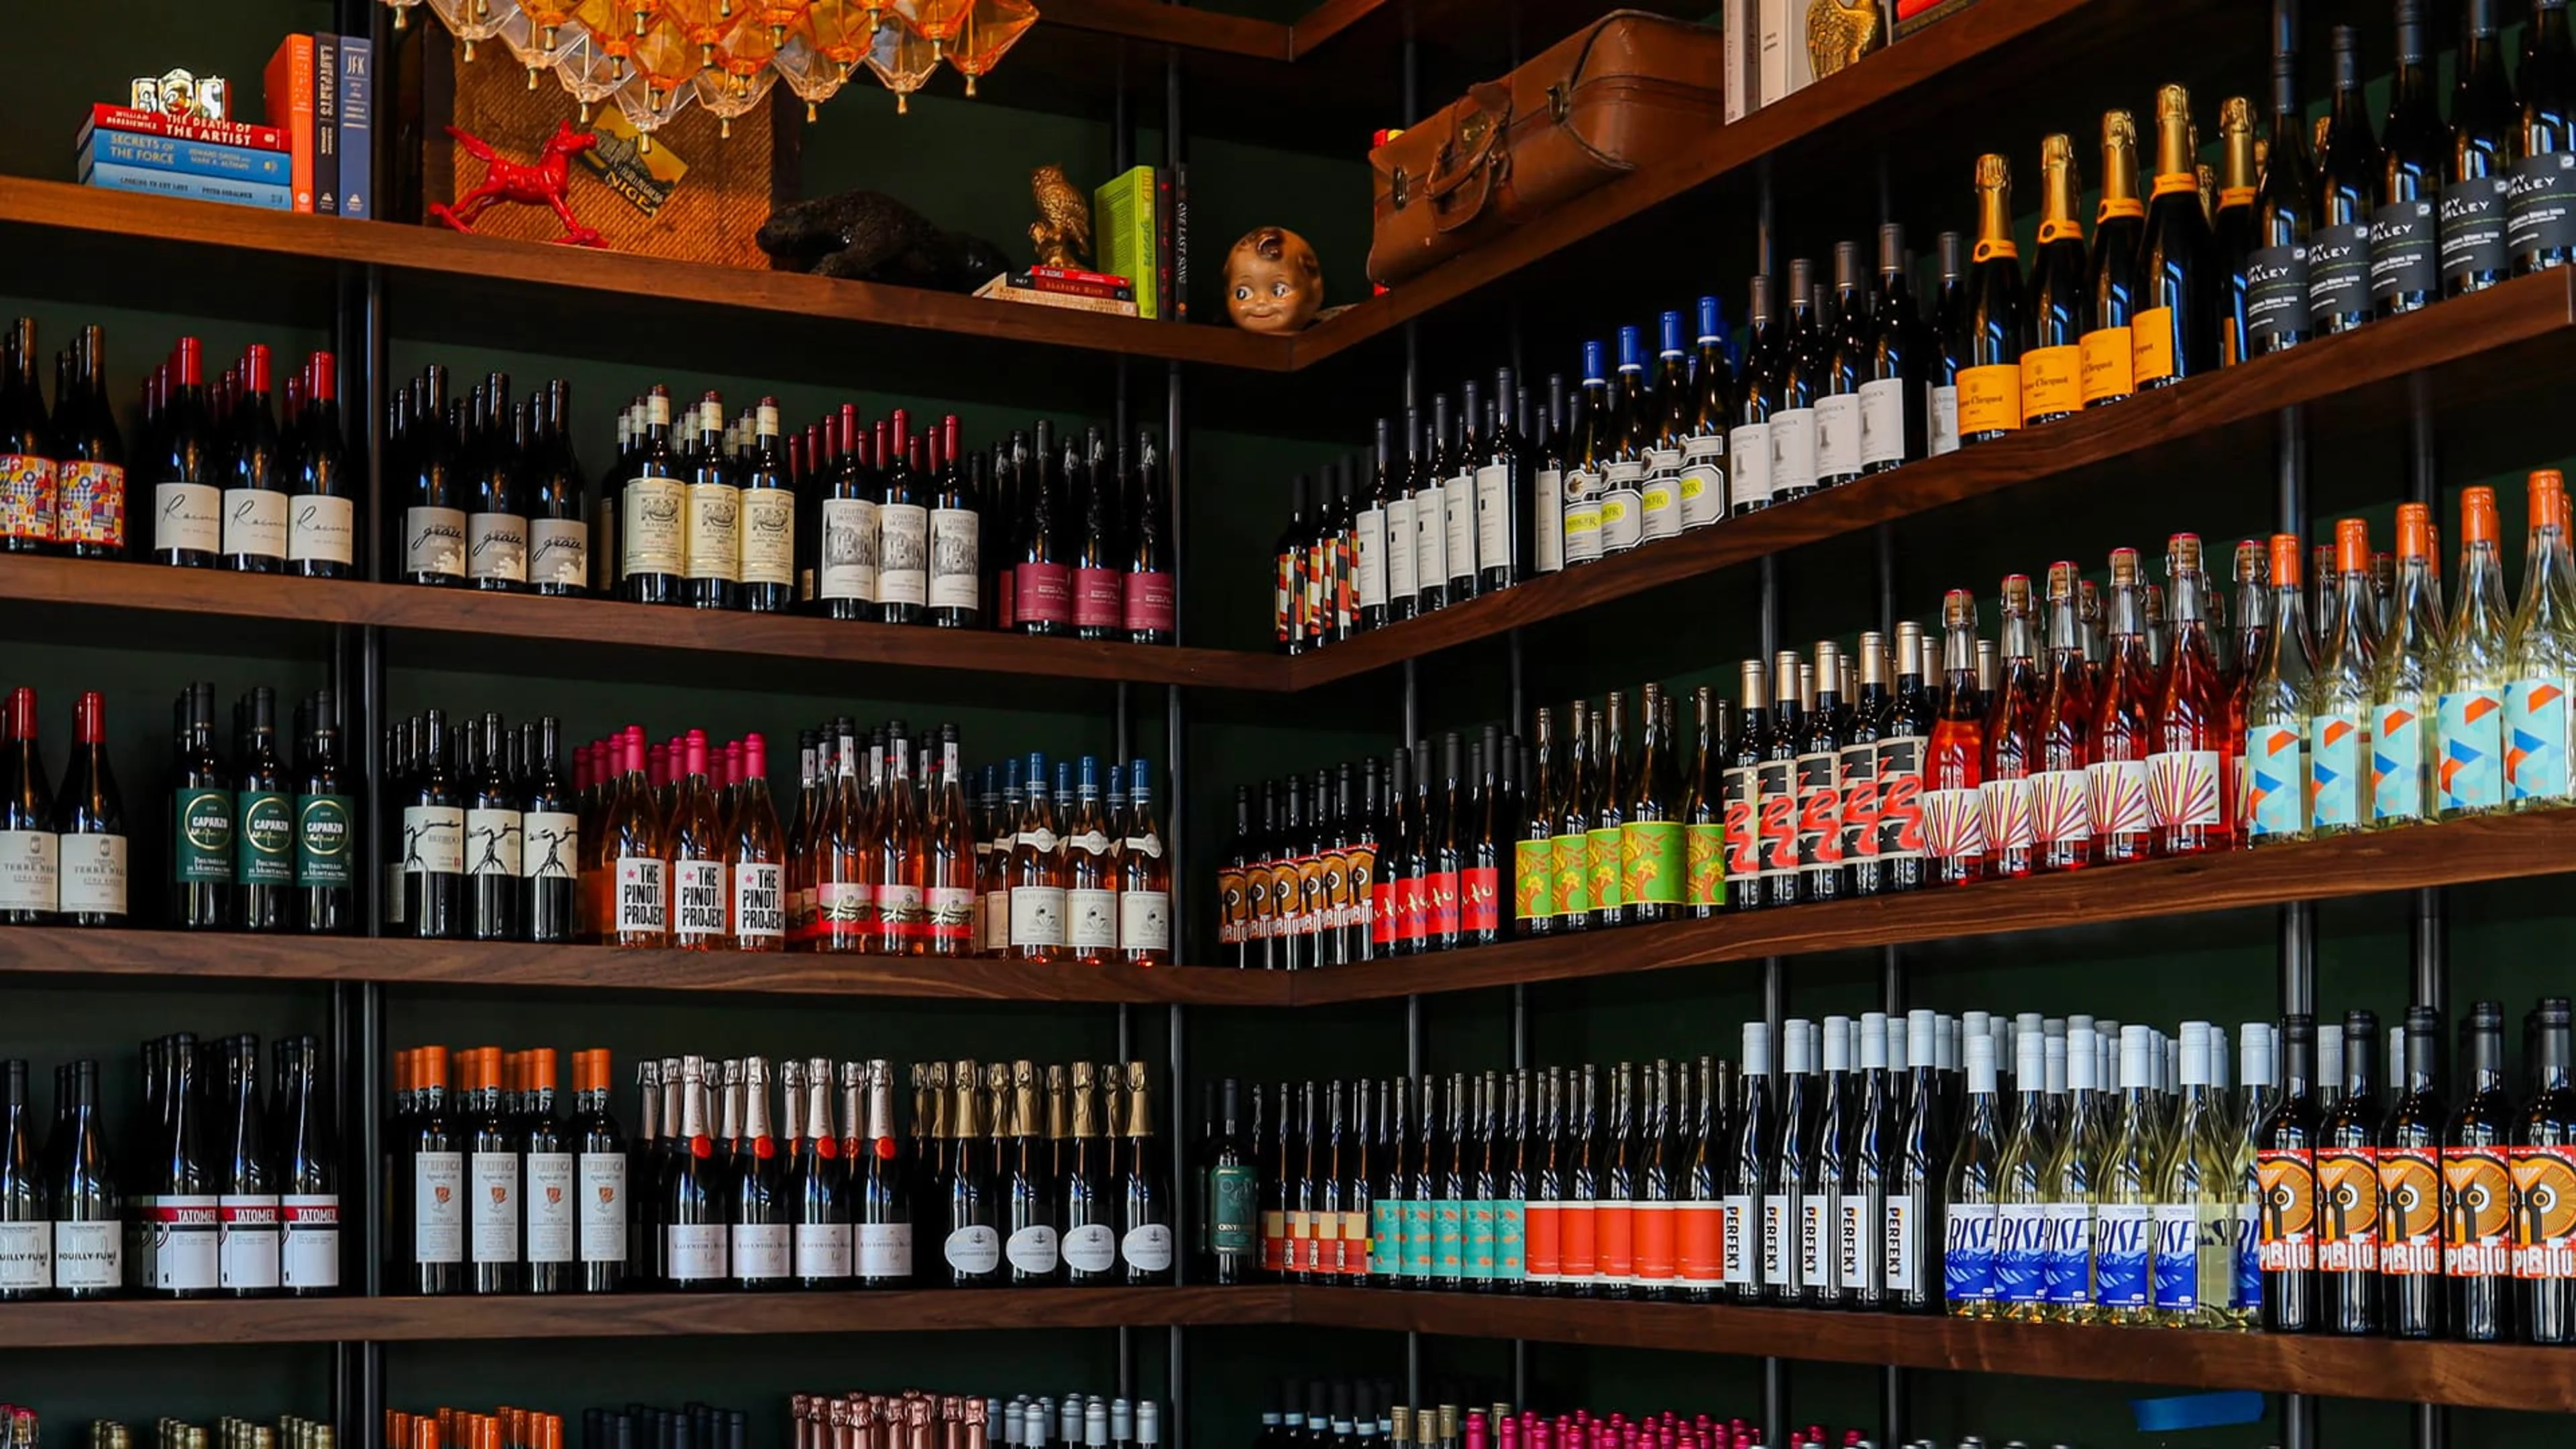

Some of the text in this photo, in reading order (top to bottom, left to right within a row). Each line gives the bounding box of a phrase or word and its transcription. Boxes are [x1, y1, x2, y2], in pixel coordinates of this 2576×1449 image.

[346, 55, 365, 75] JFK
[115, 110, 150, 121] WILLIAM
[166, 113, 252, 133] THE DEATH OF
[111, 133, 175, 152] SECRETS OF
[166, 124, 252, 146] THE ARTIST
[111, 146, 175, 165] THE FORCE
[172, 182, 189, 193] LOST
[1177, 203, 1187, 284] ONE LAST SONG
[193, 816, 228, 828] CAPARZO
[254, 819, 288, 832] CAPARZO
[307, 822, 343, 833] CAPARZO
[639, 864, 659, 884] THE
[698, 866, 718, 887] THE
[757, 869, 777, 889] THE
[625, 884, 658, 905] PINOT
[682, 887, 718, 906] PINOT
[742, 890, 777, 910] PINOT
[176, 1208, 217, 1223] TATOMER
[235, 1208, 276, 1223] TATOMER
[297, 1208, 337, 1223] TATOMER
[1726, 1207, 1739, 1271] PERFEKT
[1766, 1207, 1776, 1273] PERFEKT
[1805, 1207, 1816, 1274] PERFEKT
[1843, 1208, 1856, 1275] PERFEKT
[1888, 1208, 1900, 1277] PERFEKT
